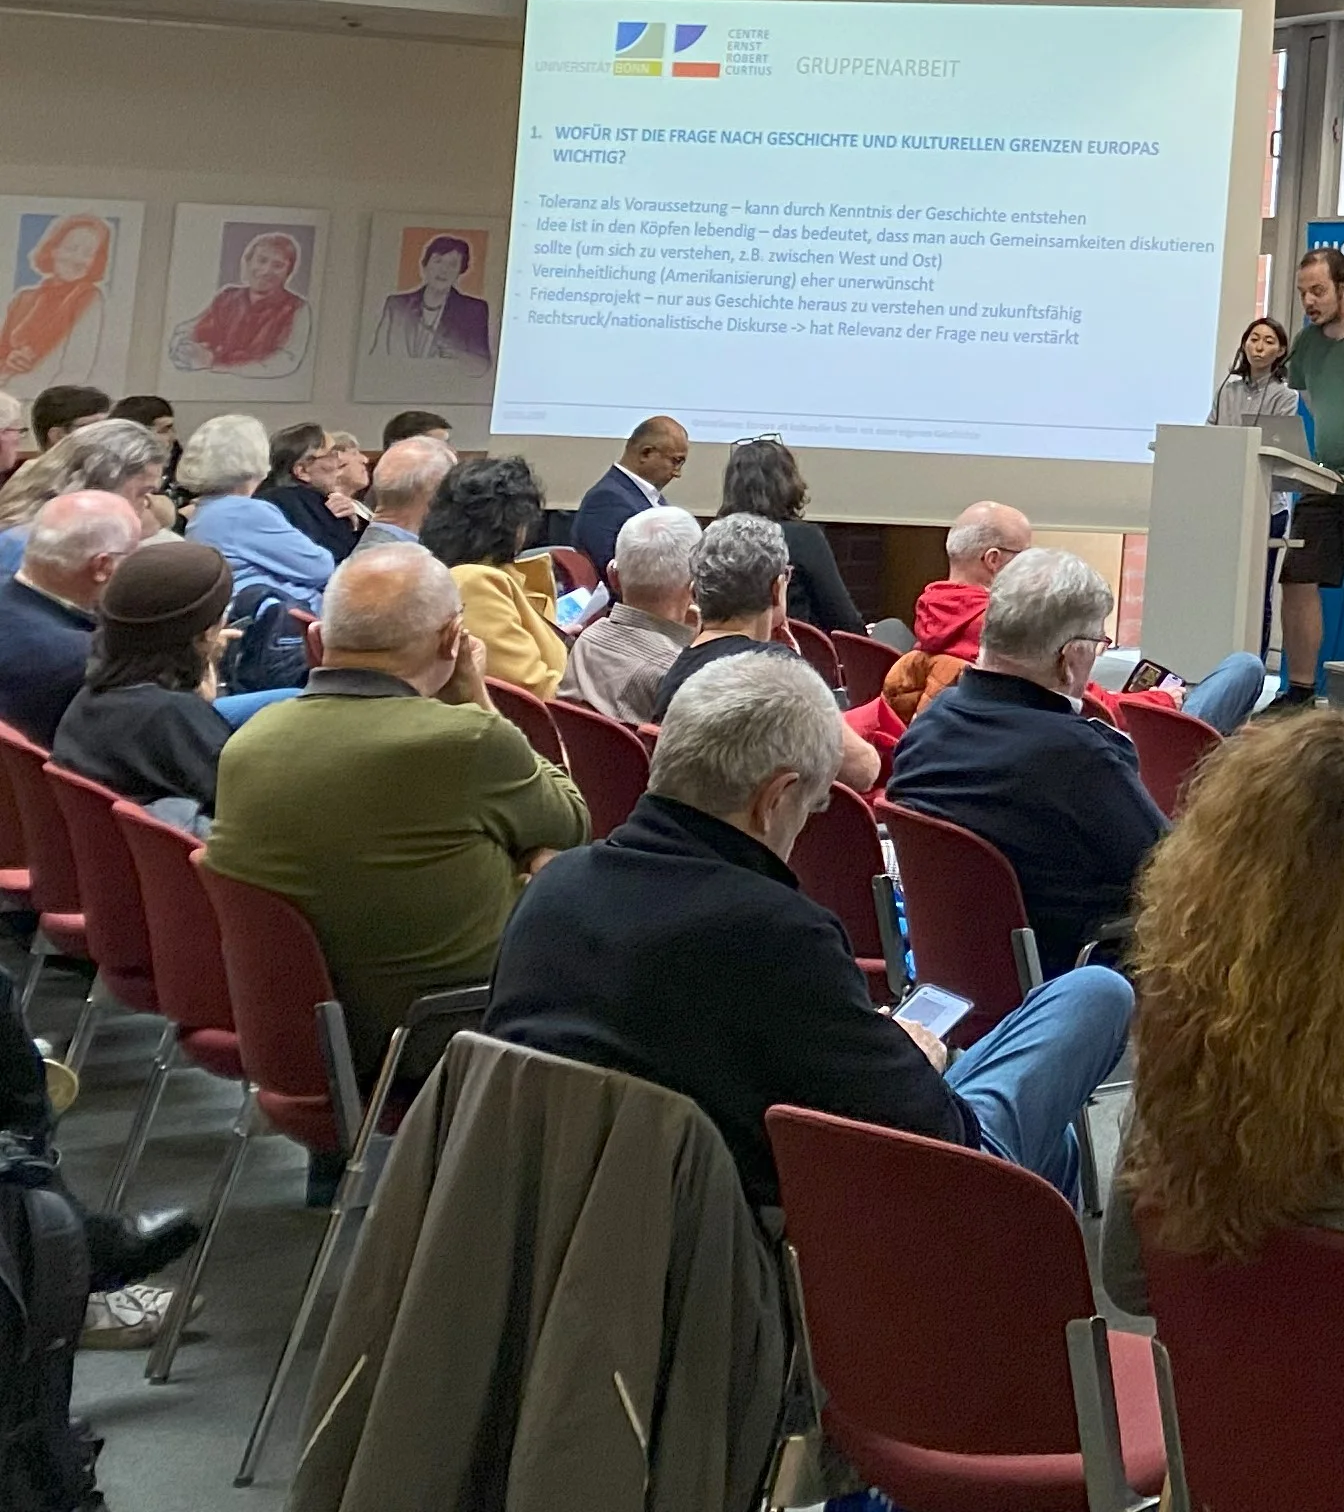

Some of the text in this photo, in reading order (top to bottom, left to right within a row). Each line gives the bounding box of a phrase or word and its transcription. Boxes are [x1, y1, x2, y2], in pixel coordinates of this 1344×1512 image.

[727, 41, 762, 51] ERNST
[728, 29, 769, 40] CENTRE
[615, 62, 650, 74] BONN
[725, 65, 772, 76] CURTIUS
[726, 53, 768, 64] ROBERT
[796, 56, 960, 78] GRUPPENARBEIT
[530, 124, 1160, 156] 1. WOFÜR IST DIE FRAGE NACH GESCHICHTE UND KULTURELLEN GRENZEN EUROPAS
[553, 149, 626, 164] WICHTIG?
[539, 194, 1086, 226] Toleranz als Voraussetzung kann durch Kenntnis der Geschichte entstehen
[536, 217, 567, 231] Idee
[591, 219, 604, 233] in
[609, 220, 635, 234] den
[640, 221, 689, 238] Köpfen
[694, 222, 755, 241] lebendig
[773, 225, 796, 239] das
[801, 226, 872, 244] bedeutet,
[877, 228, 908, 243] dass
[912, 233, 945, 245] man
[950, 231, 985, 246] auch
[990, 233, 1125, 251] Gemeinsamkeiten
[1130, 237, 1214, 253] diskutieren
[534, 241, 942, 271] sollte (um sich zu verstehen, z.B. zwischen West und Ost)
[532, 263, 934, 291] Vereinheitlichung (Amerikanisierung) eher unerwünscht
[529, 287, 1082, 324] Friedensprojekt nur aus Geschichte heraus zu verstehen und zukunftsfähig
[528, 310, 1079, 345] Rechtsruck/nationalistische Diskurse hat Relevanz der Frage neu verstärkt
